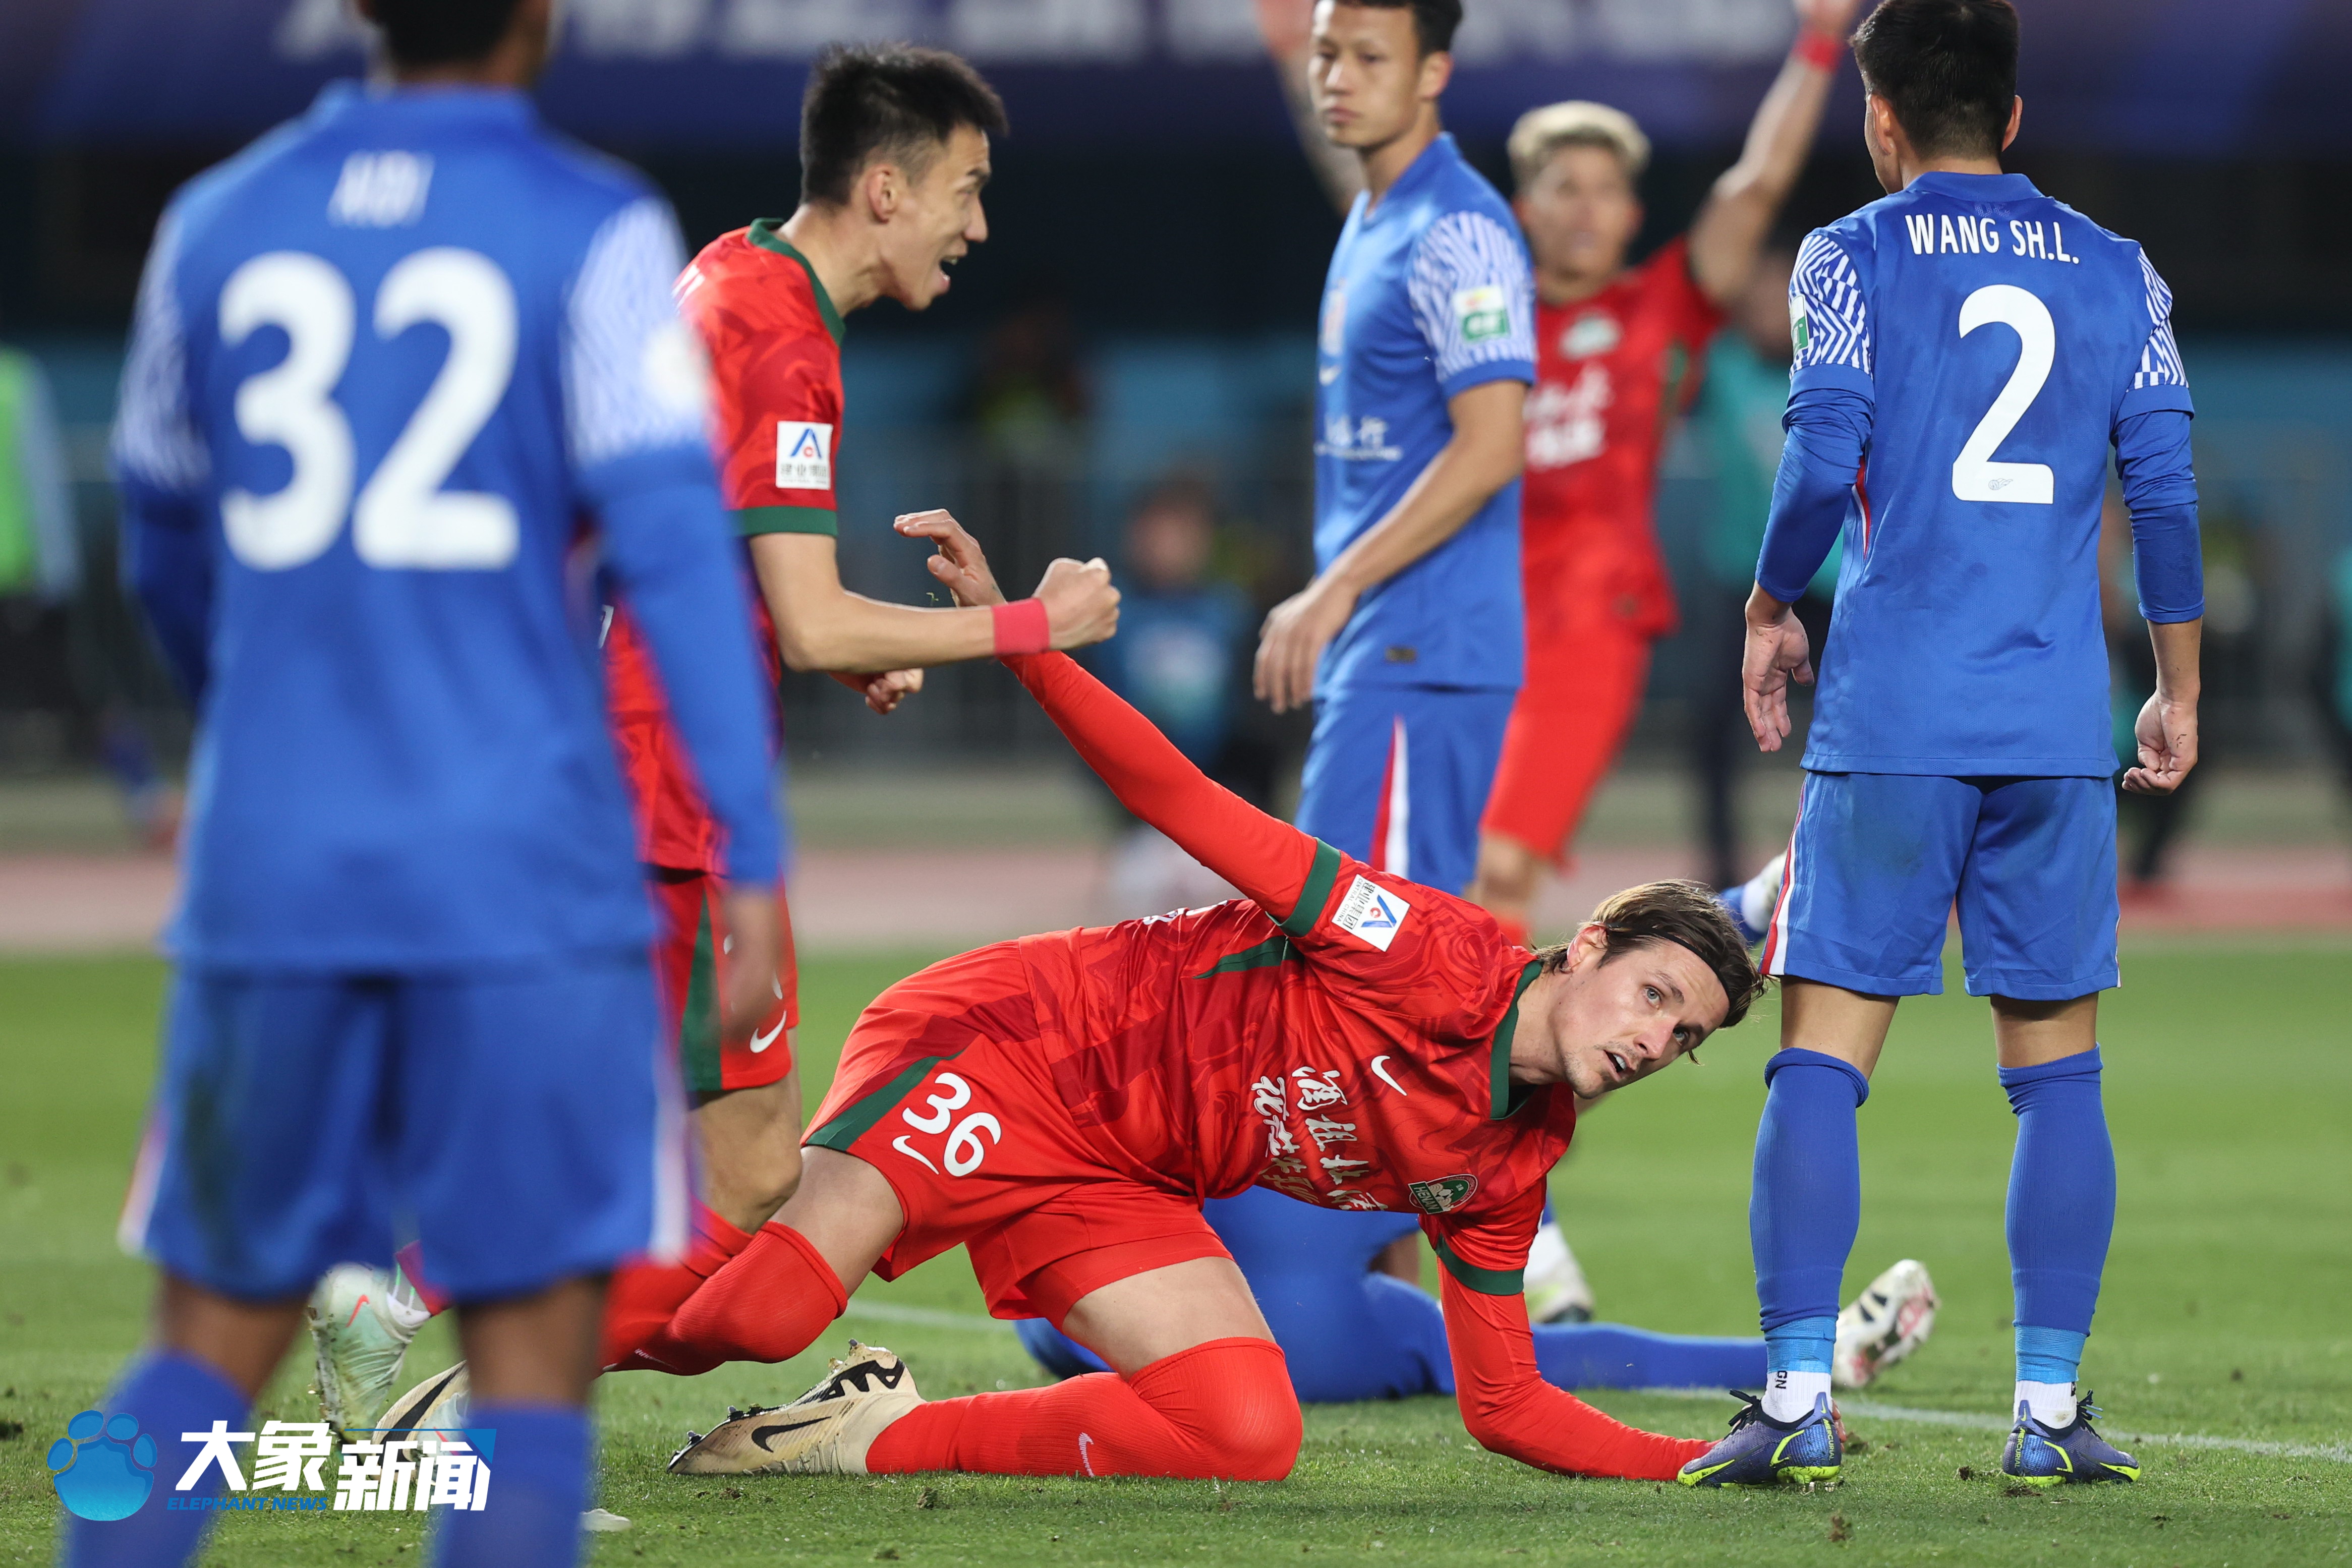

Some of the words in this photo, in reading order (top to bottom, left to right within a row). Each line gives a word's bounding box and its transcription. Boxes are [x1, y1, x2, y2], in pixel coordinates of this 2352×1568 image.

[1906, 215, 1999, 255] WANG
[2012, 220, 2079, 264] SH.L.
[218, 246, 520, 571] 32
[1952, 284, 2055, 504] 2
[1337, 904, 1350, 922] CHINA
[1343, 882, 1376, 931] 建业集团
[1348, 878, 1363, 902] CENTRAL
[902, 1072, 1002, 1177] 36
[1414, 1186, 1440, 1210] HENAN
[1823, 1418, 1835, 1461] MERCURIAL
[2014, 1427, 2026, 1468] MERCURIAL
